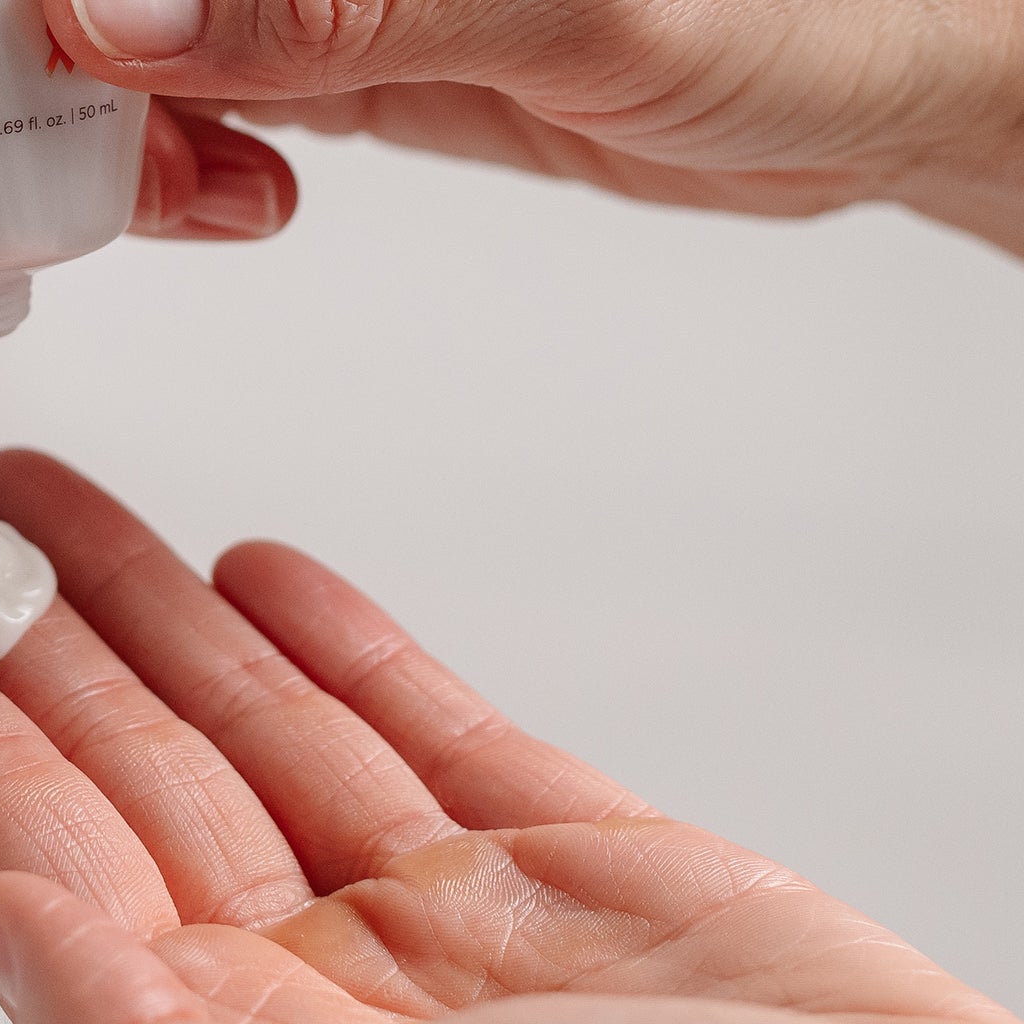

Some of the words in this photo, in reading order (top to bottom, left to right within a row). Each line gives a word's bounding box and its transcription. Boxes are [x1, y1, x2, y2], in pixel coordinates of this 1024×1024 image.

[28, 116, 42, 130] fl.
[46, 115, 67, 128] oz.
[79, 104, 96, 121] 50
[99, 99, 118, 116] mL
